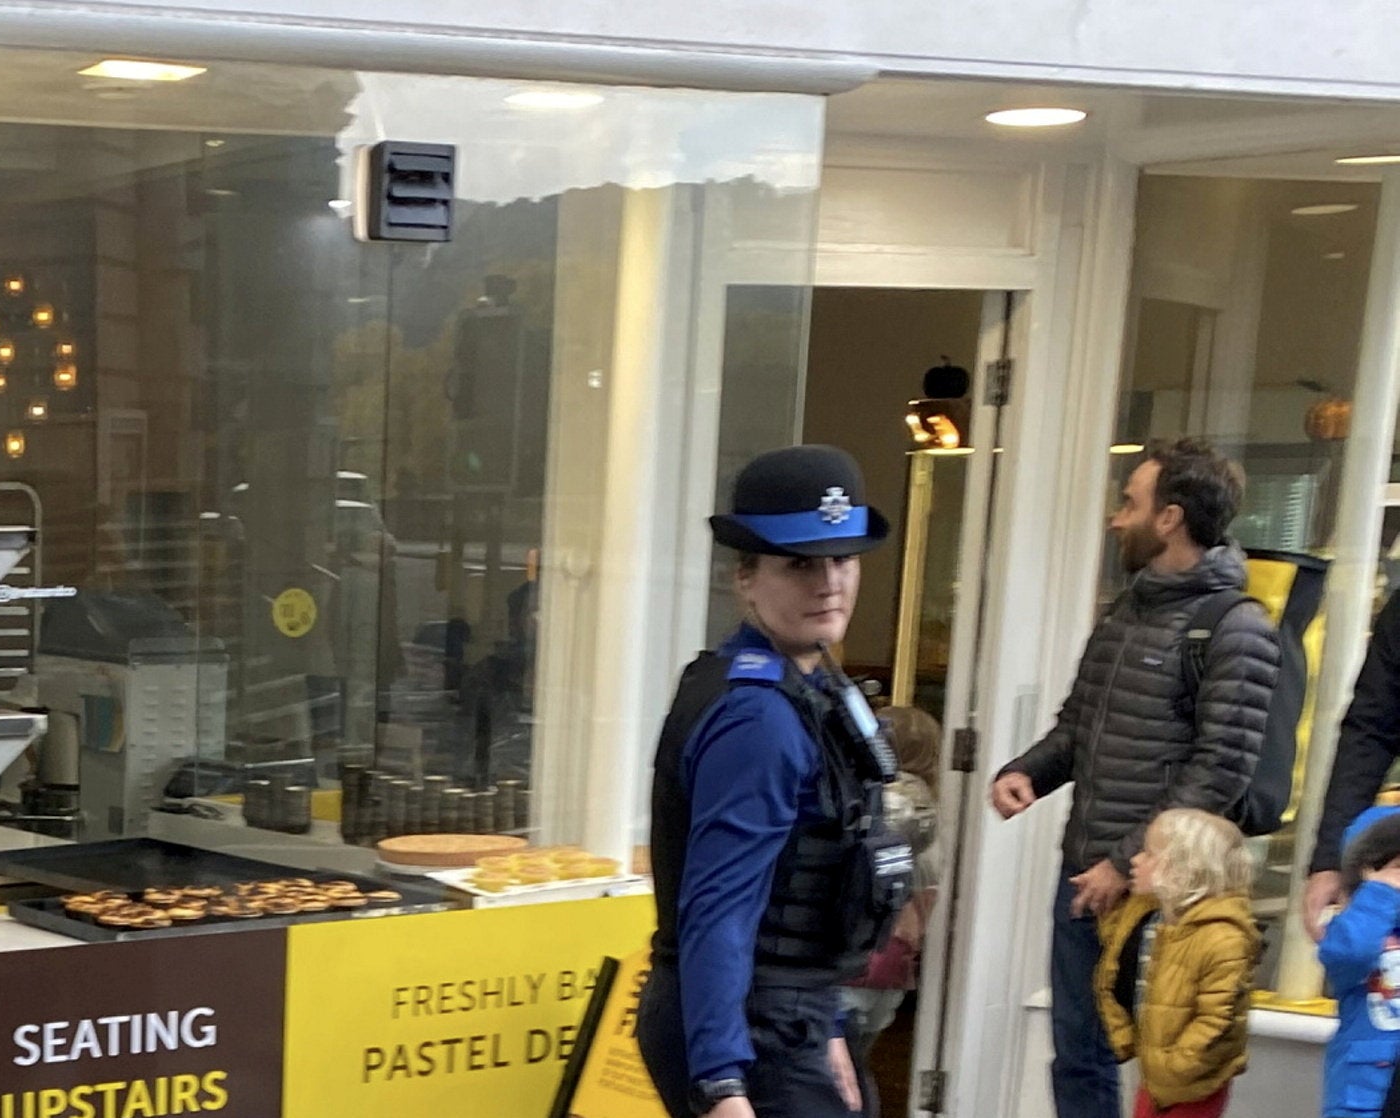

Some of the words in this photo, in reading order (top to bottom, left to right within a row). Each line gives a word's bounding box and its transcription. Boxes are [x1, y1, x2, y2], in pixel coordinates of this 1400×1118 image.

[391, 972, 547, 1019] FRESHLY
[12, 1006, 218, 1067] SEATING
[361, 1032, 510, 1084] PASTEL
[525, 1024, 578, 1065] DE
